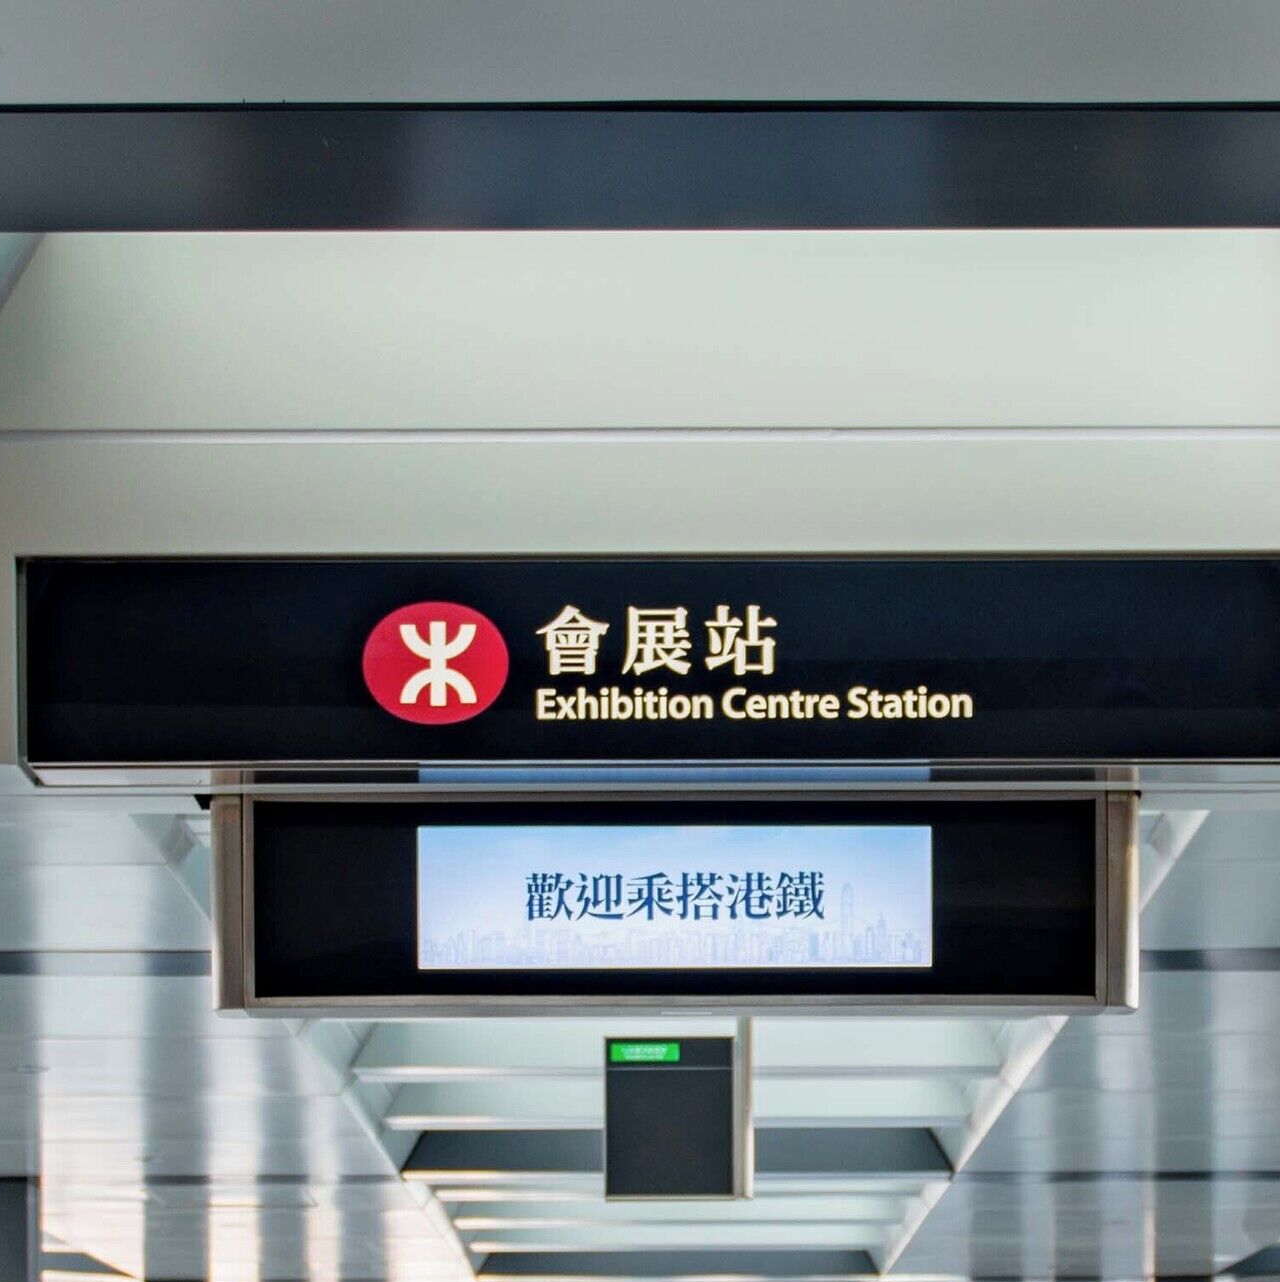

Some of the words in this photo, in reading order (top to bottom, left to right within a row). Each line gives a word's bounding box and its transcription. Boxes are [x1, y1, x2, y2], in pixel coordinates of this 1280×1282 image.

[535, 604, 778, 676] 會展站
[536, 687, 714, 720] Exhibition
[721, 687, 840, 720] Centre
[847, 686, 973, 720] Station
[525, 871, 826, 921] 歡迎乘搭港鐵
